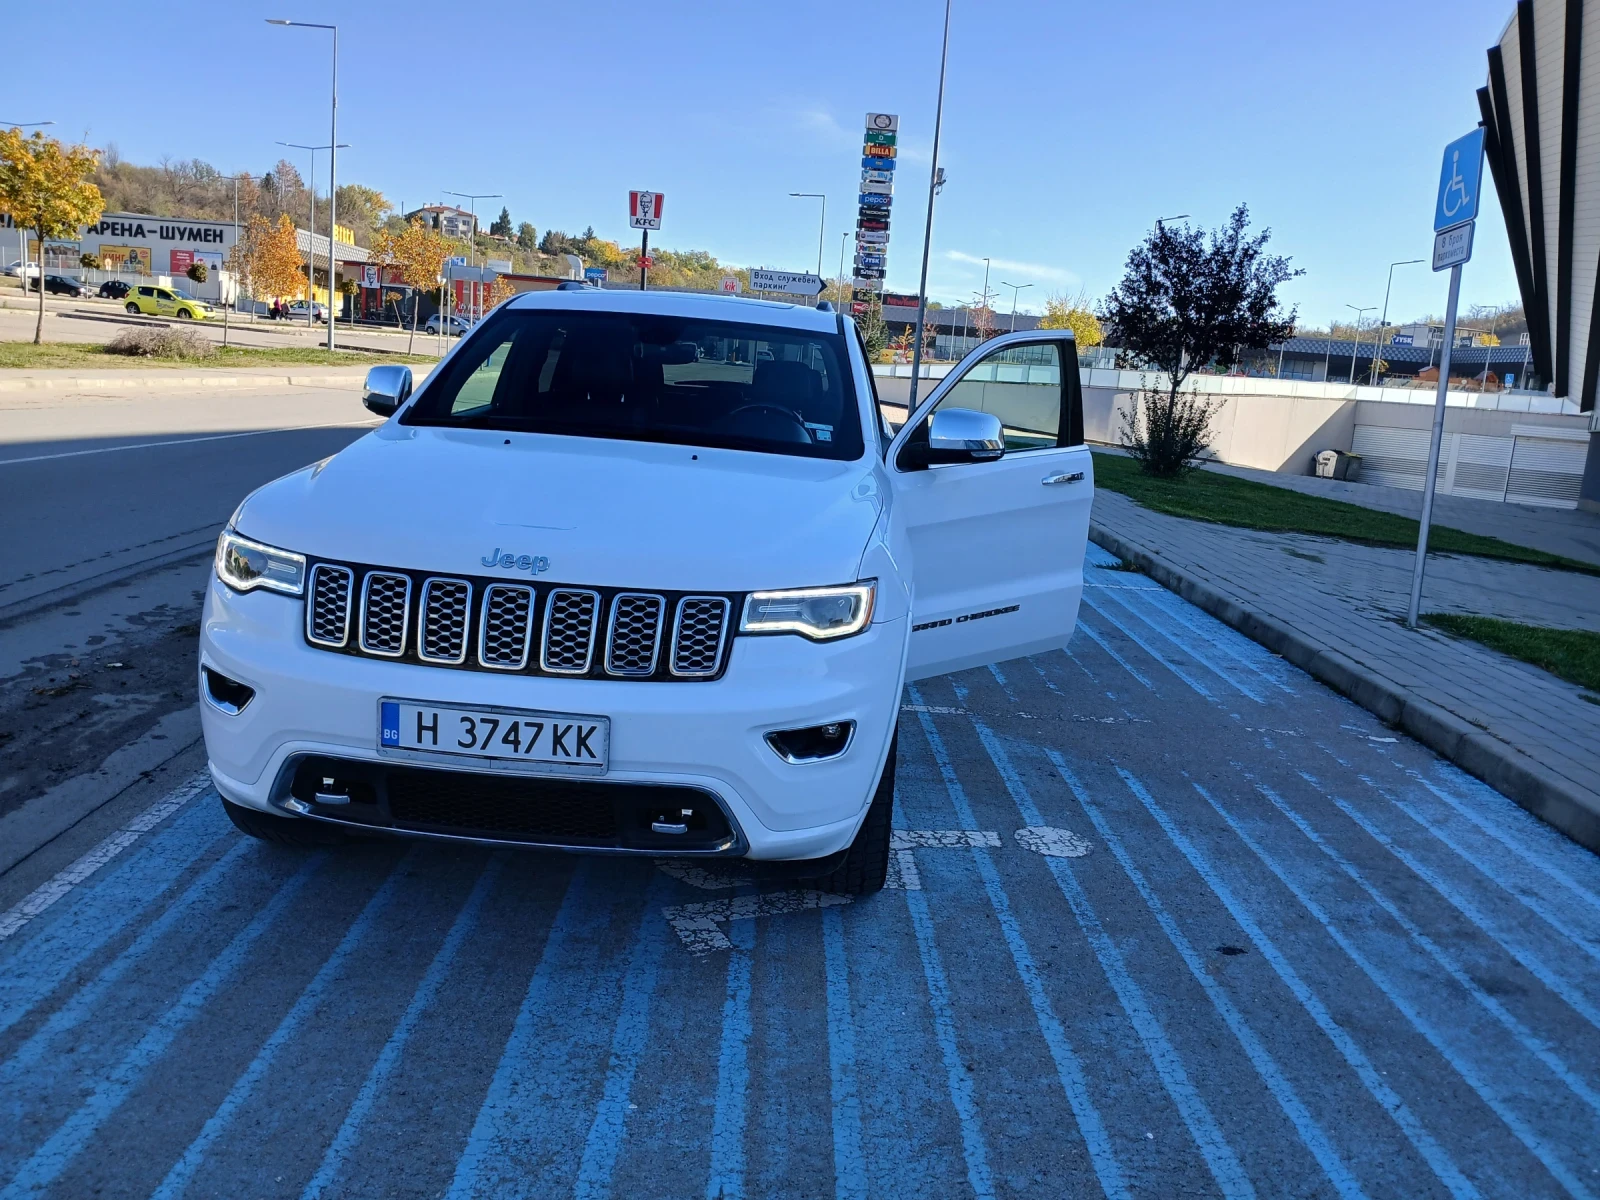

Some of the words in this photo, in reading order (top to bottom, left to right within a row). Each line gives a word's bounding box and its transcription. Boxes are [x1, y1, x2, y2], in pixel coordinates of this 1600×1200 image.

[870, 147, 890, 155] BILLA
[864, 196, 888, 204] pepco
[634, 217, 656, 227] KFC
[1441, 236, 1447, 248] 8
[1449, 233, 1463, 248] броя
[586, 271, 606, 279] pepco
[754, 271, 774, 282] Вход
[777, 275, 816, 285] служебен
[724, 280, 736, 291] kik
[753, 282, 788, 292] паркинг
[1395, 335, 1413, 344] JYSK
[481, 547, 550, 576] Jeep
[955, 604, 1021, 623] CHEROKEE
[383, 728, 398, 739] BG
[416, 711, 439, 746] H
[457, 716, 544, 754] 3747
[551, 723, 598, 759] KK
